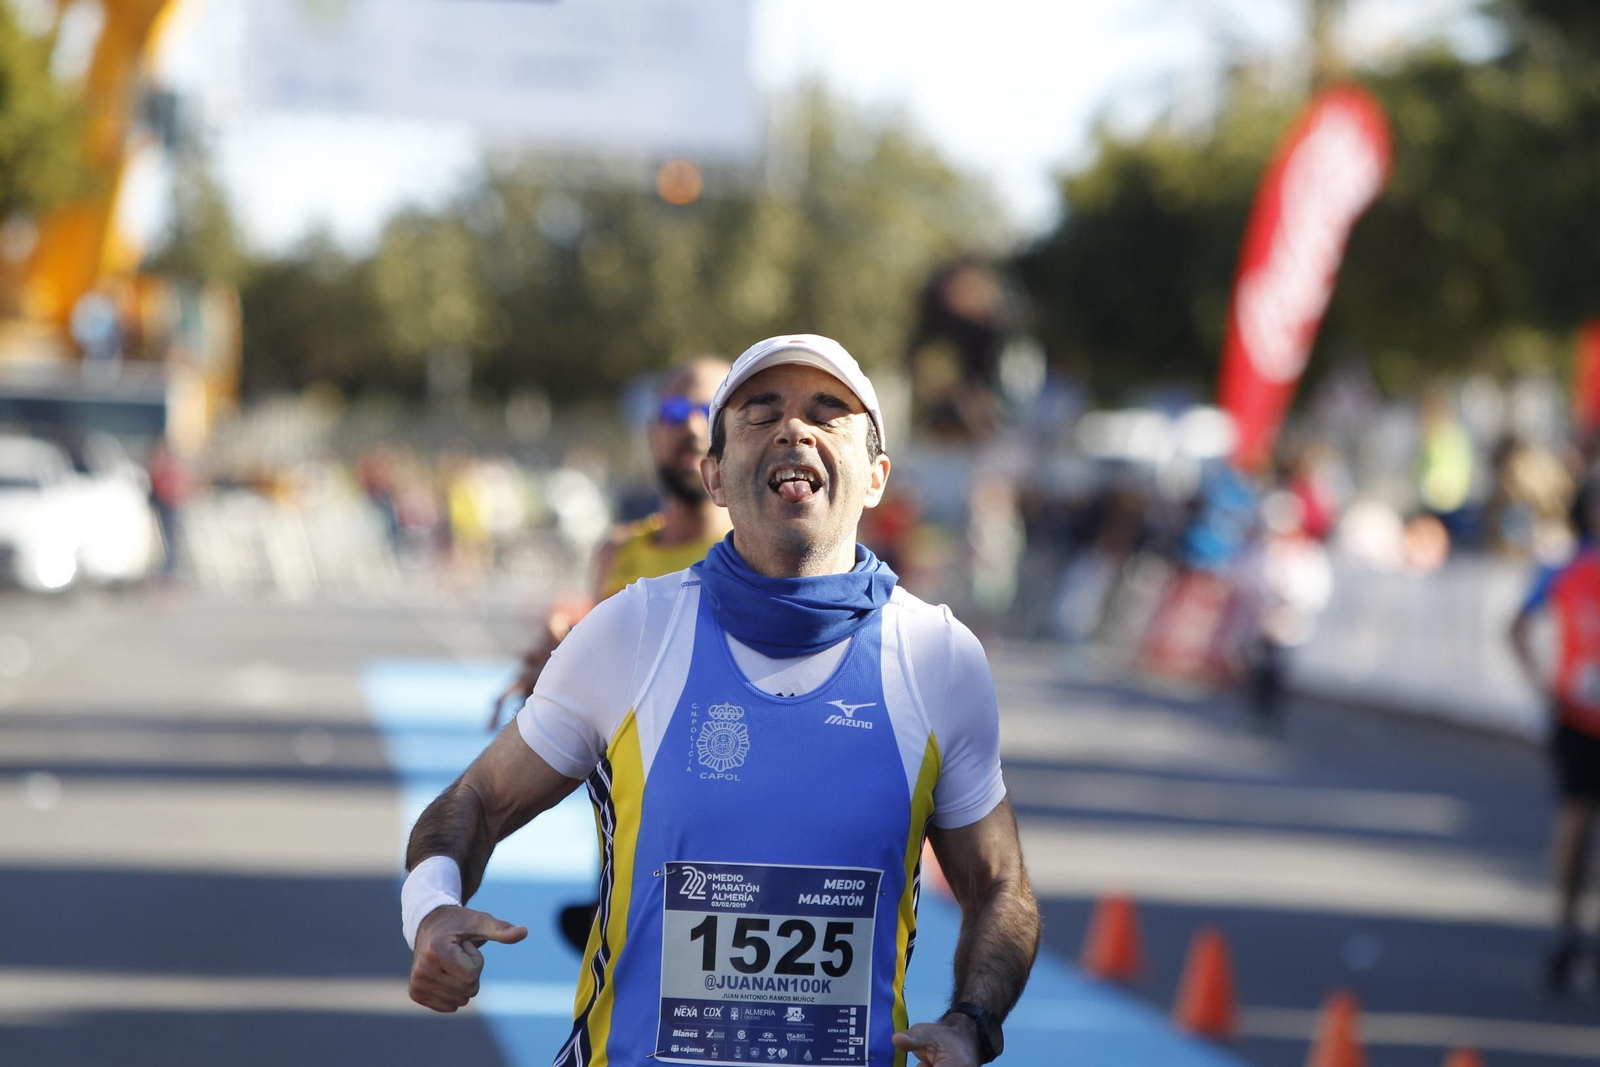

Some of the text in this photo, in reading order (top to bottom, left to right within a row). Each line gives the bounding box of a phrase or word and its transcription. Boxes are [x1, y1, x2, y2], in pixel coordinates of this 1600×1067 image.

[700, 772, 741, 781] CAPOL
[712, 874, 743, 882] MEDIO
[712, 883, 760, 893] MARATÓN
[823, 879, 866, 890] MEDIO
[711, 892, 754, 902] ALMERÍA
[798, 893, 864, 907] MARATÓN
[690, 915, 854, 977] 1525
[704, 974, 832, 994] @JUANAN100K
[672, 1029, 699, 1038] Blanes
[680, 1046, 705, 1054] cajamar
